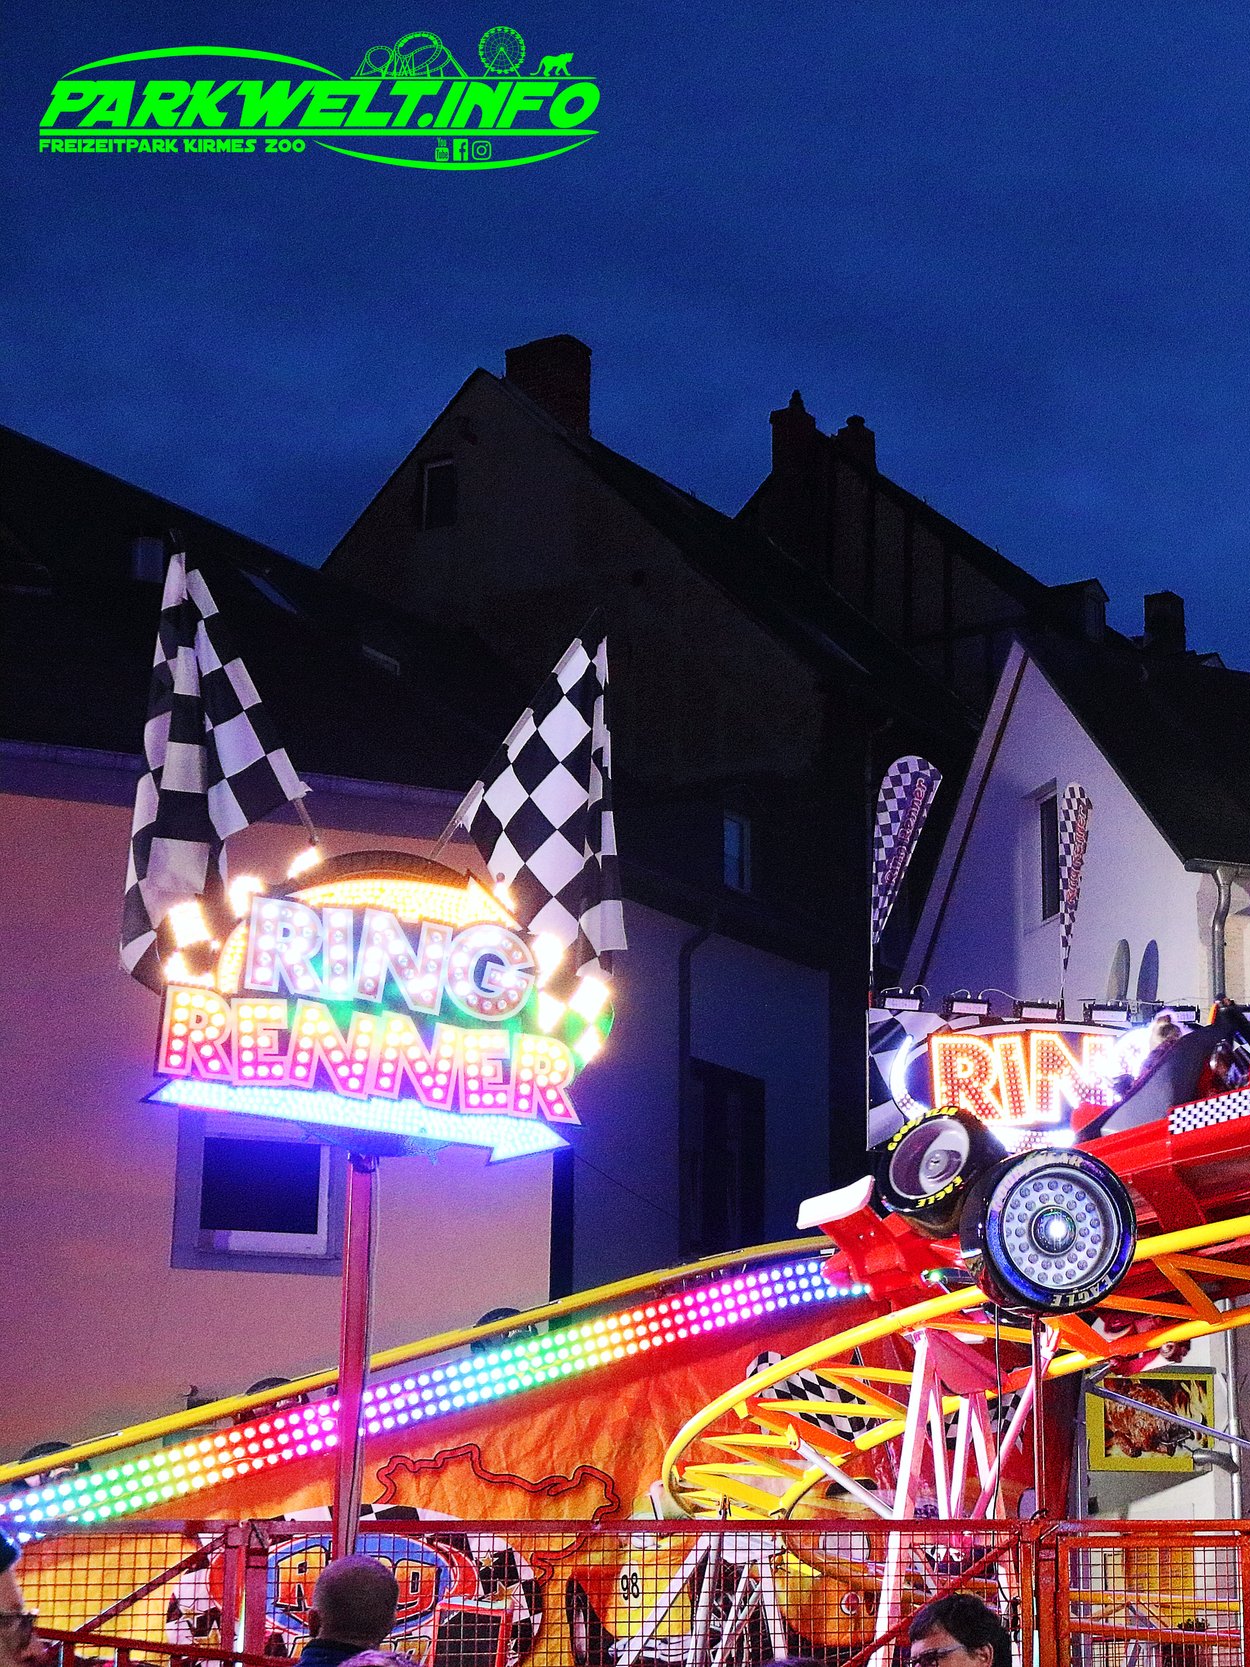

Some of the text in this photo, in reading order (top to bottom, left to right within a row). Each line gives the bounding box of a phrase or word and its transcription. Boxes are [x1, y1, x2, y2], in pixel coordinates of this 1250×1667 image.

[898, 778, 927, 843] Renner
[243, 895, 539, 1022] RING
[154, 985, 581, 1125] RENNER
[620, 1572, 640, 1601] 98
